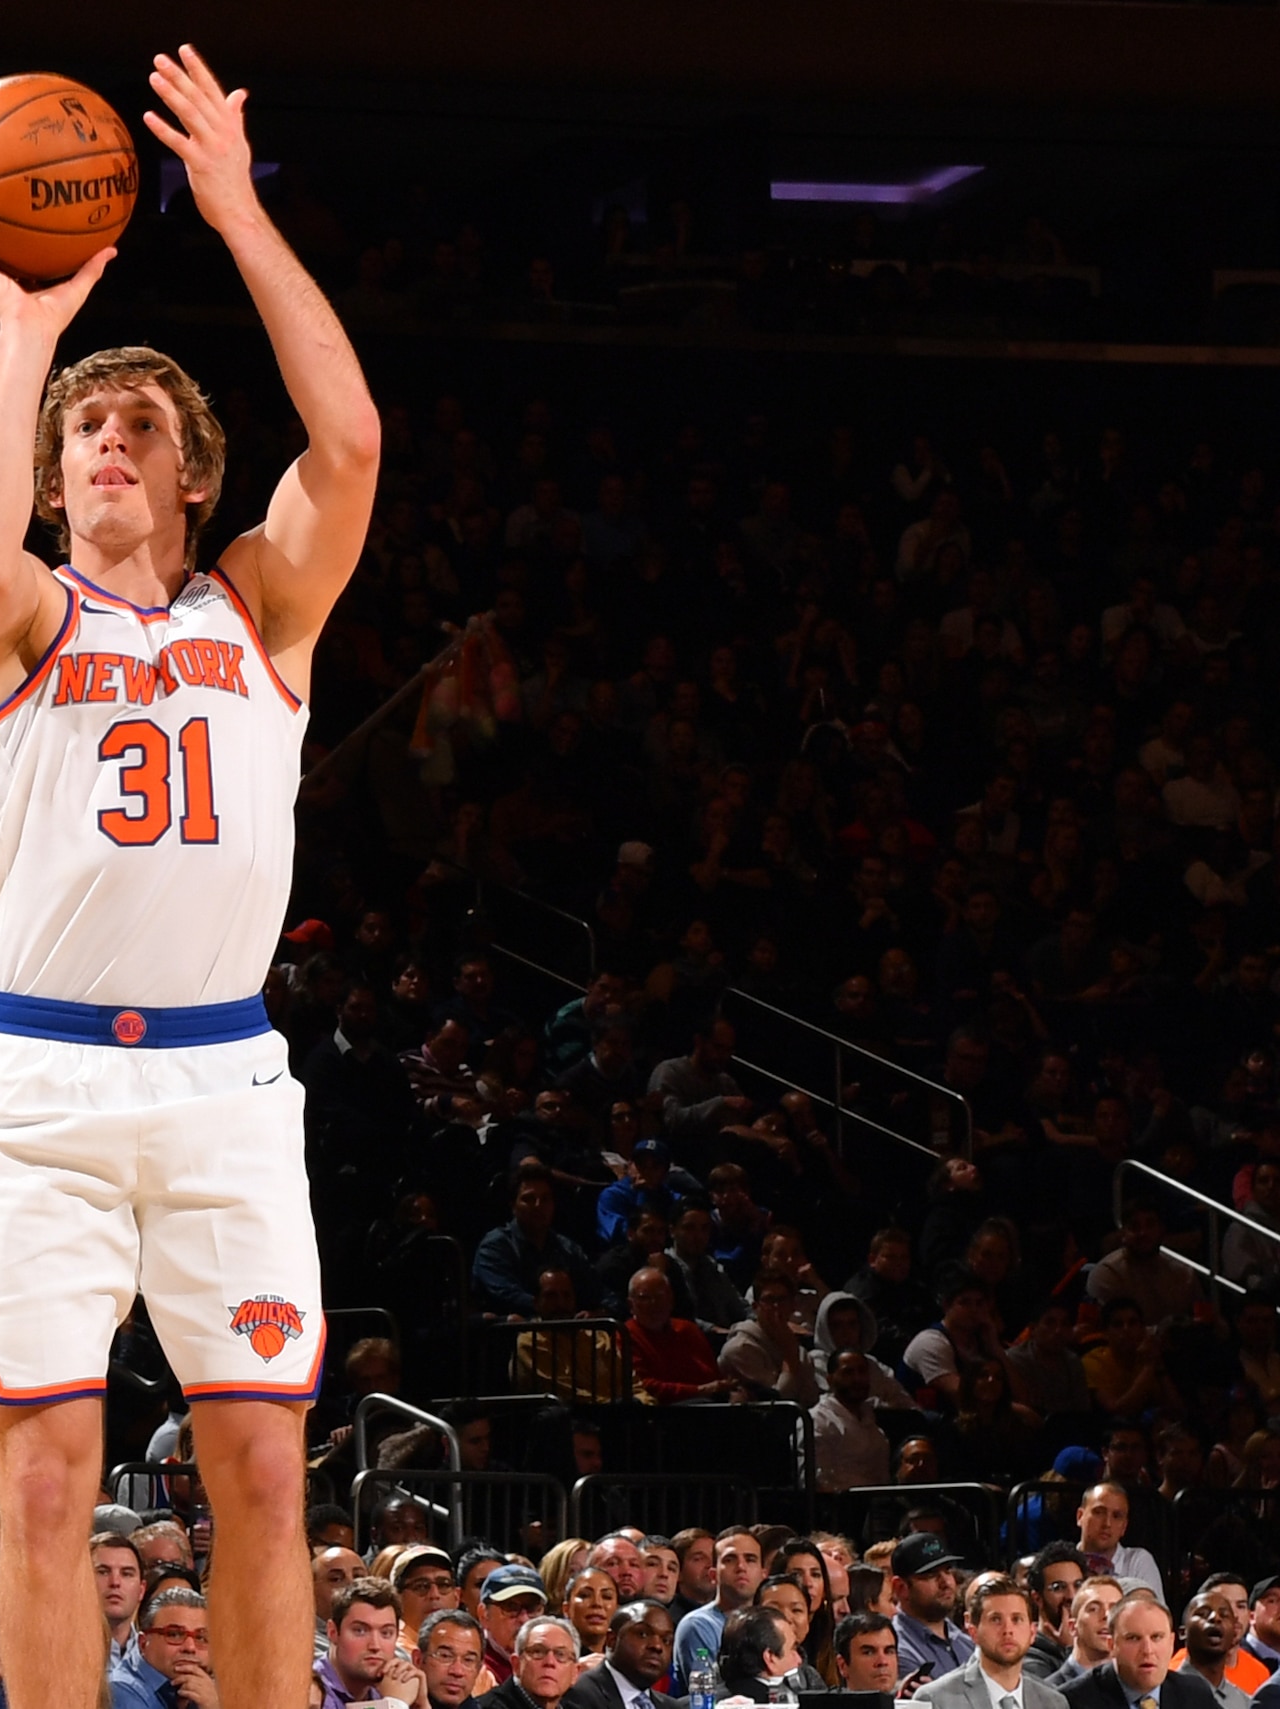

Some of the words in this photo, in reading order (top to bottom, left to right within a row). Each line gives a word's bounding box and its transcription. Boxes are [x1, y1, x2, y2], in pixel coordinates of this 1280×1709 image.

[52, 652, 158, 707] NEW
[156, 638, 250, 699] YORK
[98, 717, 219, 847] 31
[230, 1299, 304, 1337] KNICKS
